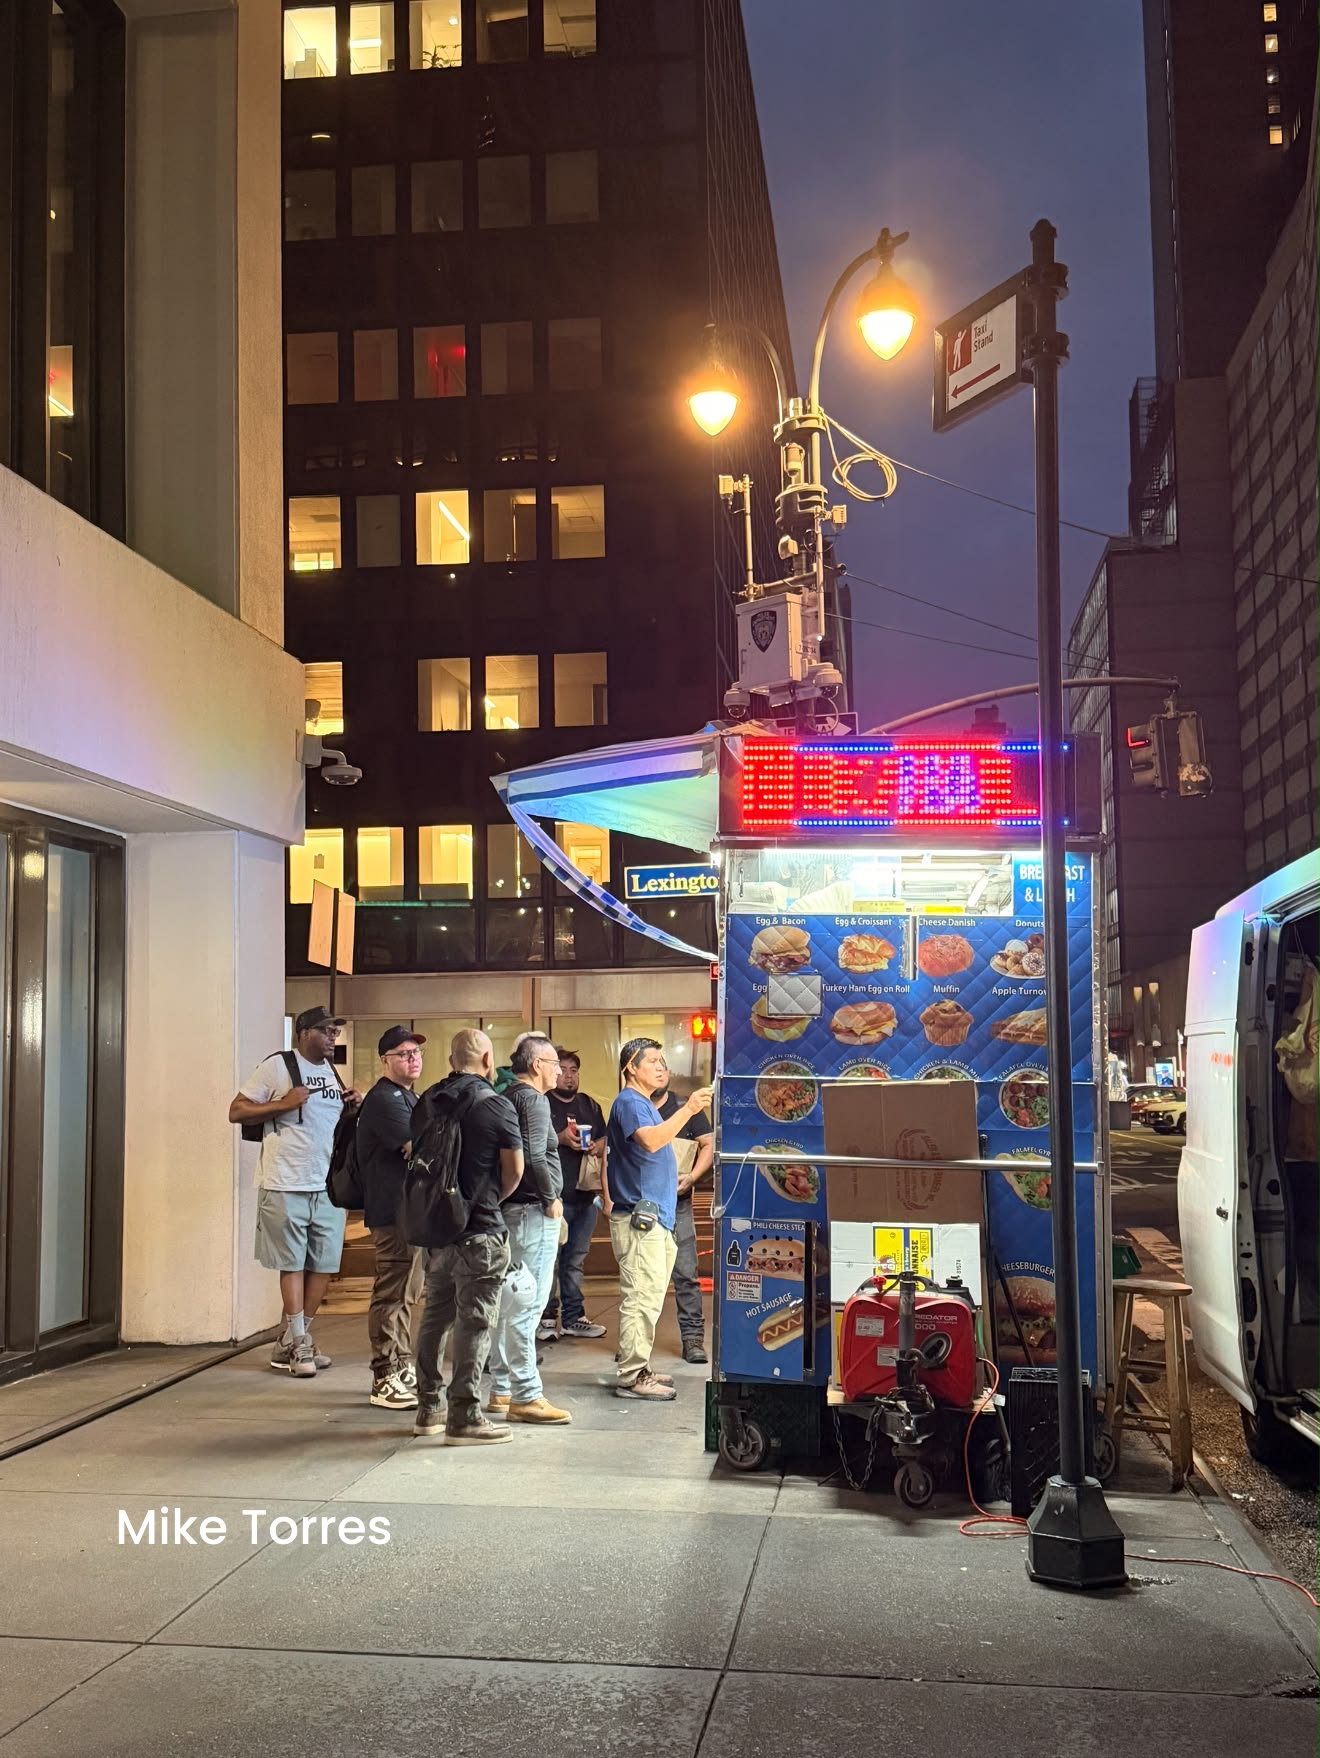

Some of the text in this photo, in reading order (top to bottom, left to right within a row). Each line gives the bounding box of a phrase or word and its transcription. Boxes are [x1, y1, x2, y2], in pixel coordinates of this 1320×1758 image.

[973, 320, 988, 338] Taxi
[973, 330, 994, 352] Stand
[1019, 864, 1086, 881] BREAST
[630, 872, 720, 894] Lexingto
[755, 916, 771, 925] Egg
[782, 917, 806, 925] Bacon
[835, 917, 849, 927] Egg
[857, 917, 892, 926] Croissant
[918, 917, 976, 927] Cheese Danish
[1015, 919, 1045, 928] Donuts
[752, 983, 768, 993] Egg
[822, 984, 847, 993] Turkey
[848, 985, 866, 993] Ham
[867, 985, 882, 994] Egg
[895, 985, 911, 993] Roll
[933, 985, 960, 993] Muffin
[991, 986, 1017, 997] Apple
[913, 1059, 940, 1080] CHICKEN
[305, 1076, 326, 1088] JUST
[322, 1088, 336, 1100] DO
[1038, 1148, 1051, 1157] GYR
[752, 1221, 768, 1229] PHILI
[768, 1222, 791, 1231] CHEESE
[1000, 1260, 1055, 1278] HEESEBURGER
[735, 1274, 760, 1282] DANGER
[745, 1306, 761, 1319] HOT
[914, 1313, 958, 1321] REDATOR
[914, 1323, 936, 1331] 000
